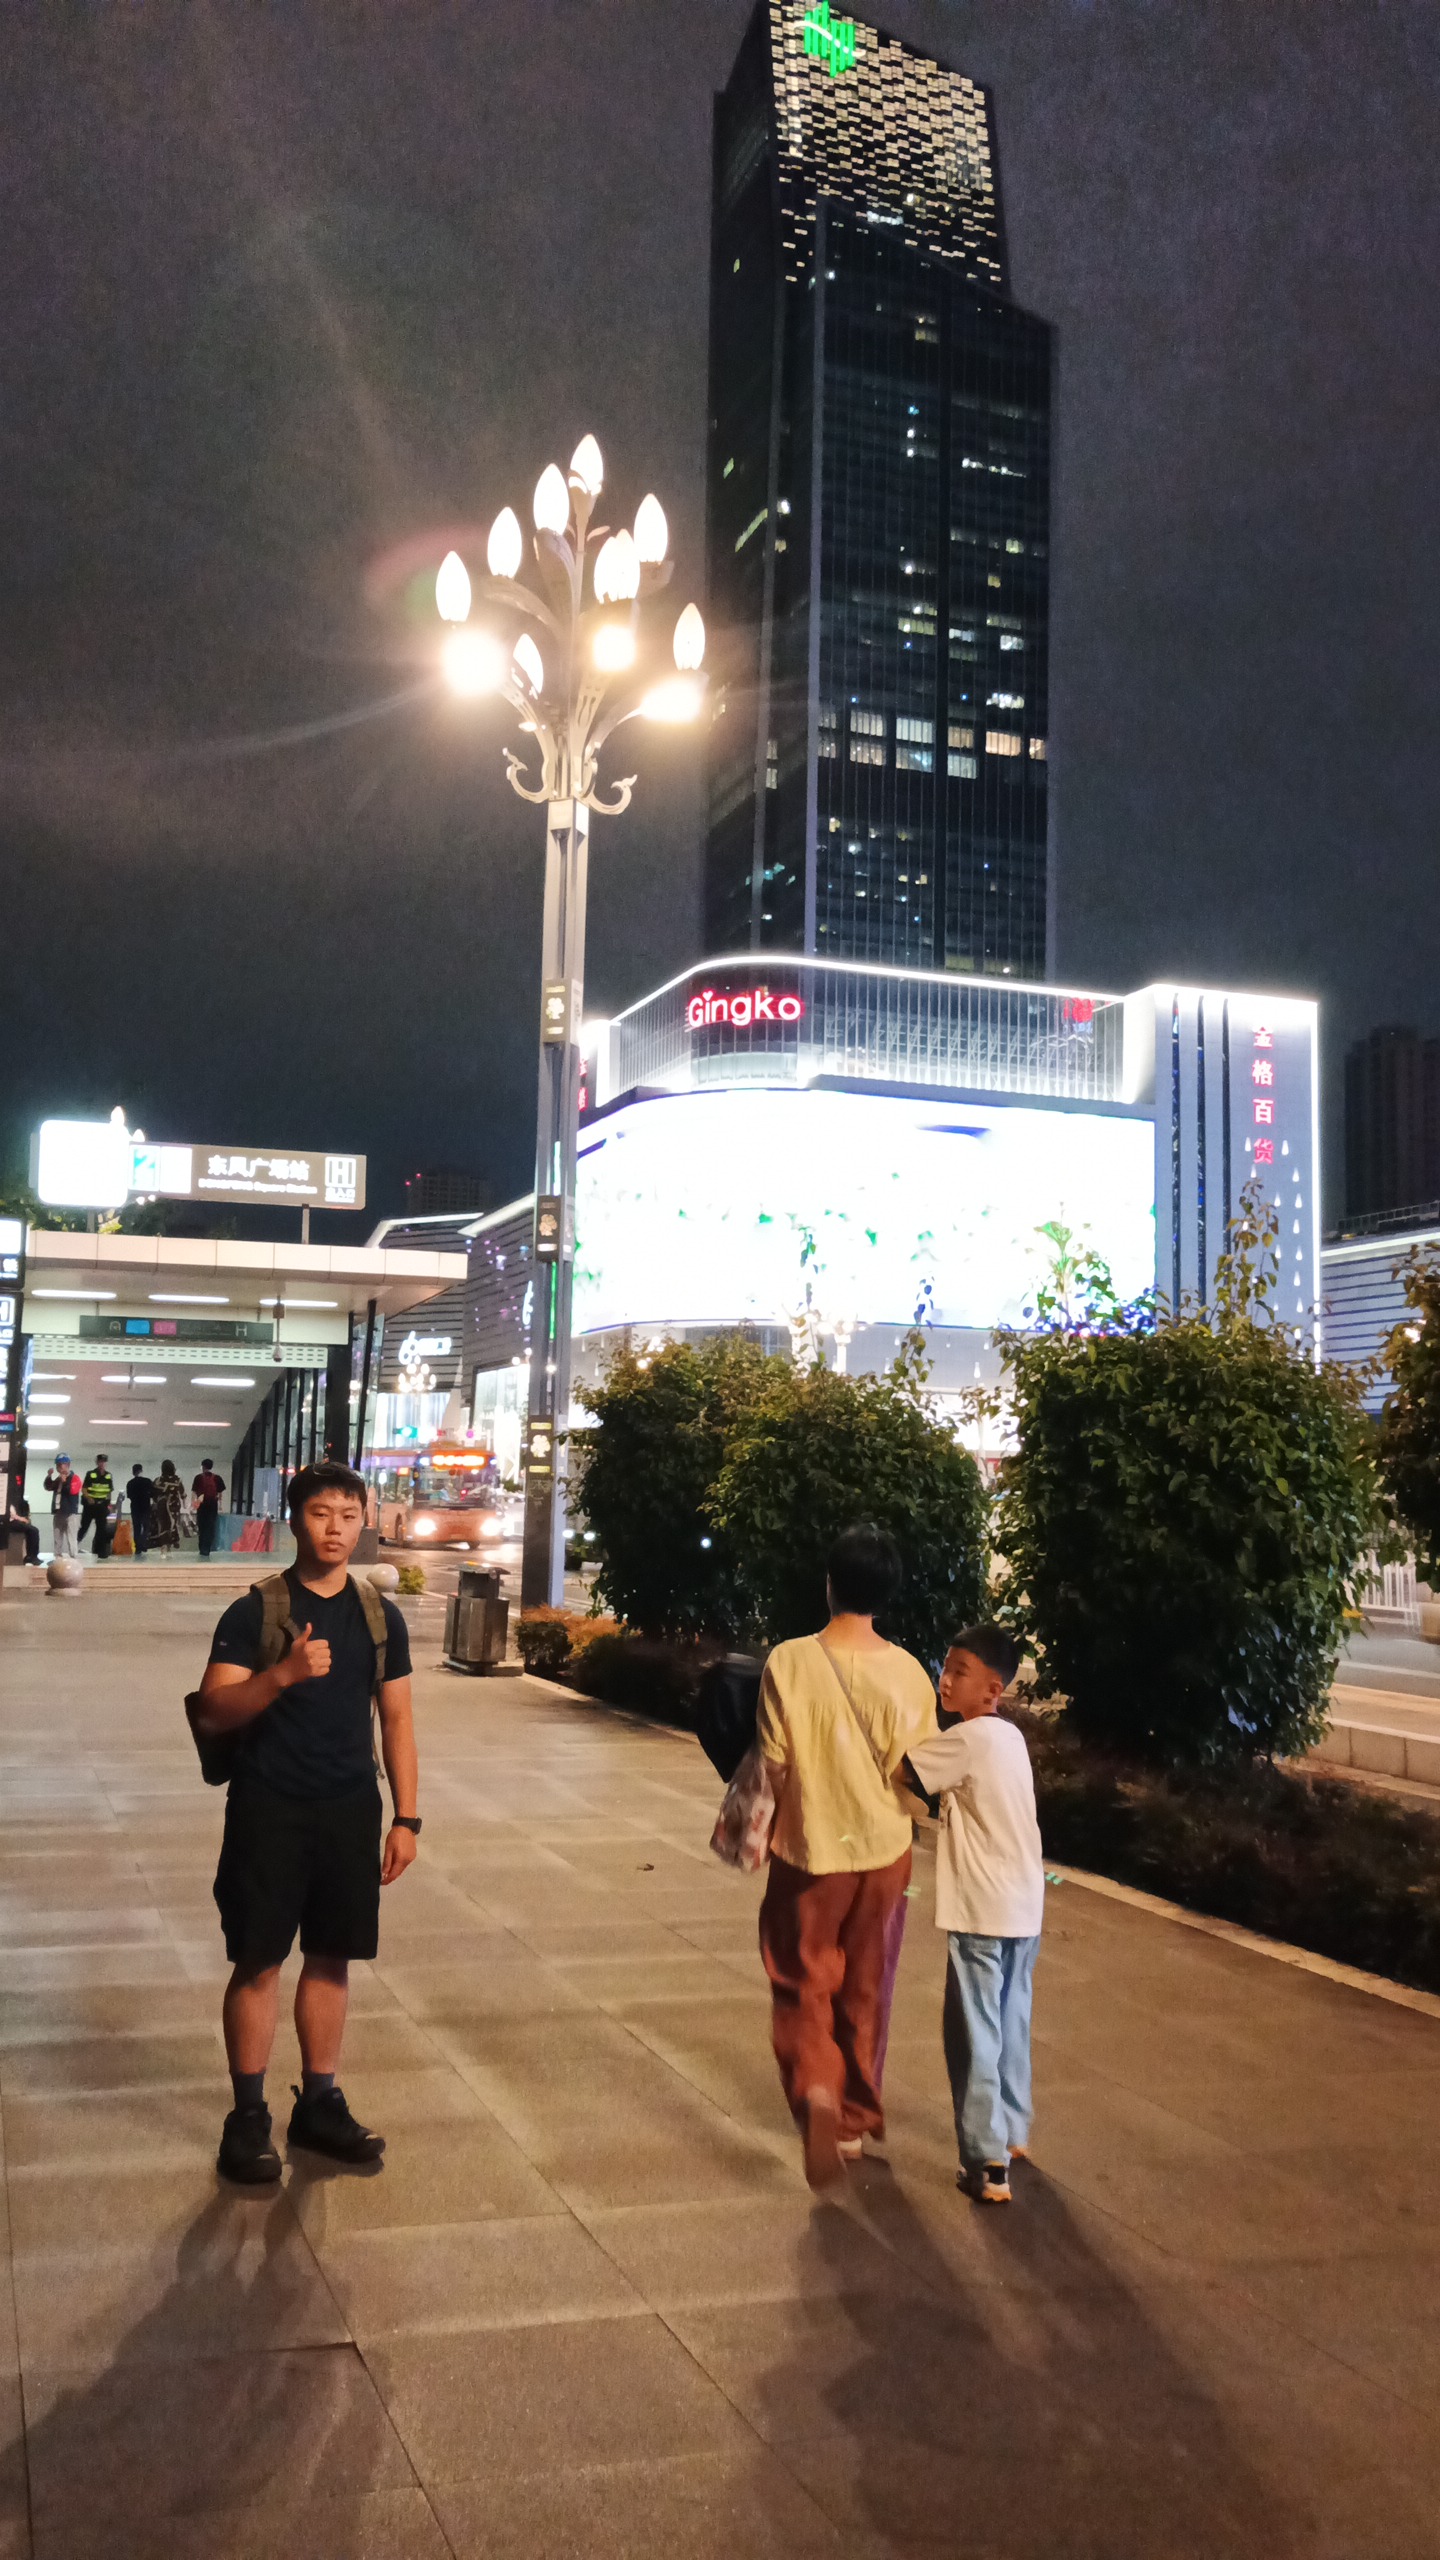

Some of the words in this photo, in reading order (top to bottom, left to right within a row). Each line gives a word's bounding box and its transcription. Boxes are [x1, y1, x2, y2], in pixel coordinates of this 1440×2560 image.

[688, 990, 801, 1027] Gingko
[1252, 1023, 1274, 1164] 金格百货
[207, 1154, 310, 1181] 东风广场站
[235, 1323, 248, 1337] H
